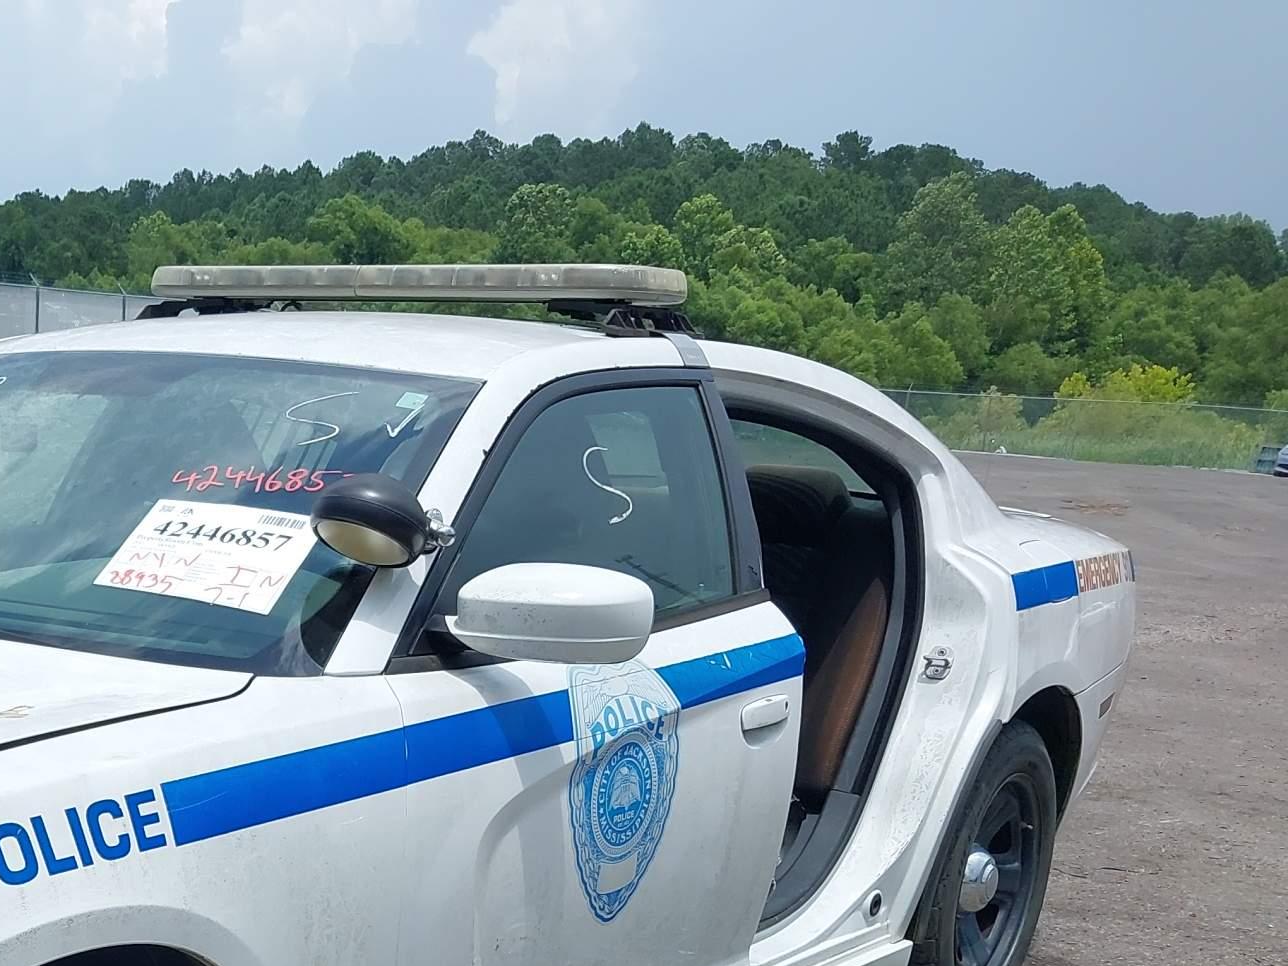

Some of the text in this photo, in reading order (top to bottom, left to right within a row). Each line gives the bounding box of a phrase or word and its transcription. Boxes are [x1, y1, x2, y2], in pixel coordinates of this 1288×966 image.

[172, 465, 355, 494] 4244685
[153, 520, 294, 551] 42446857
[590, 695, 668, 760] POLICE
[599, 745, 652, 803] CITY OF JACKSON
[599, 802, 649, 845] MISSISSIPPI
[613, 810, 635, 823] POLICE
